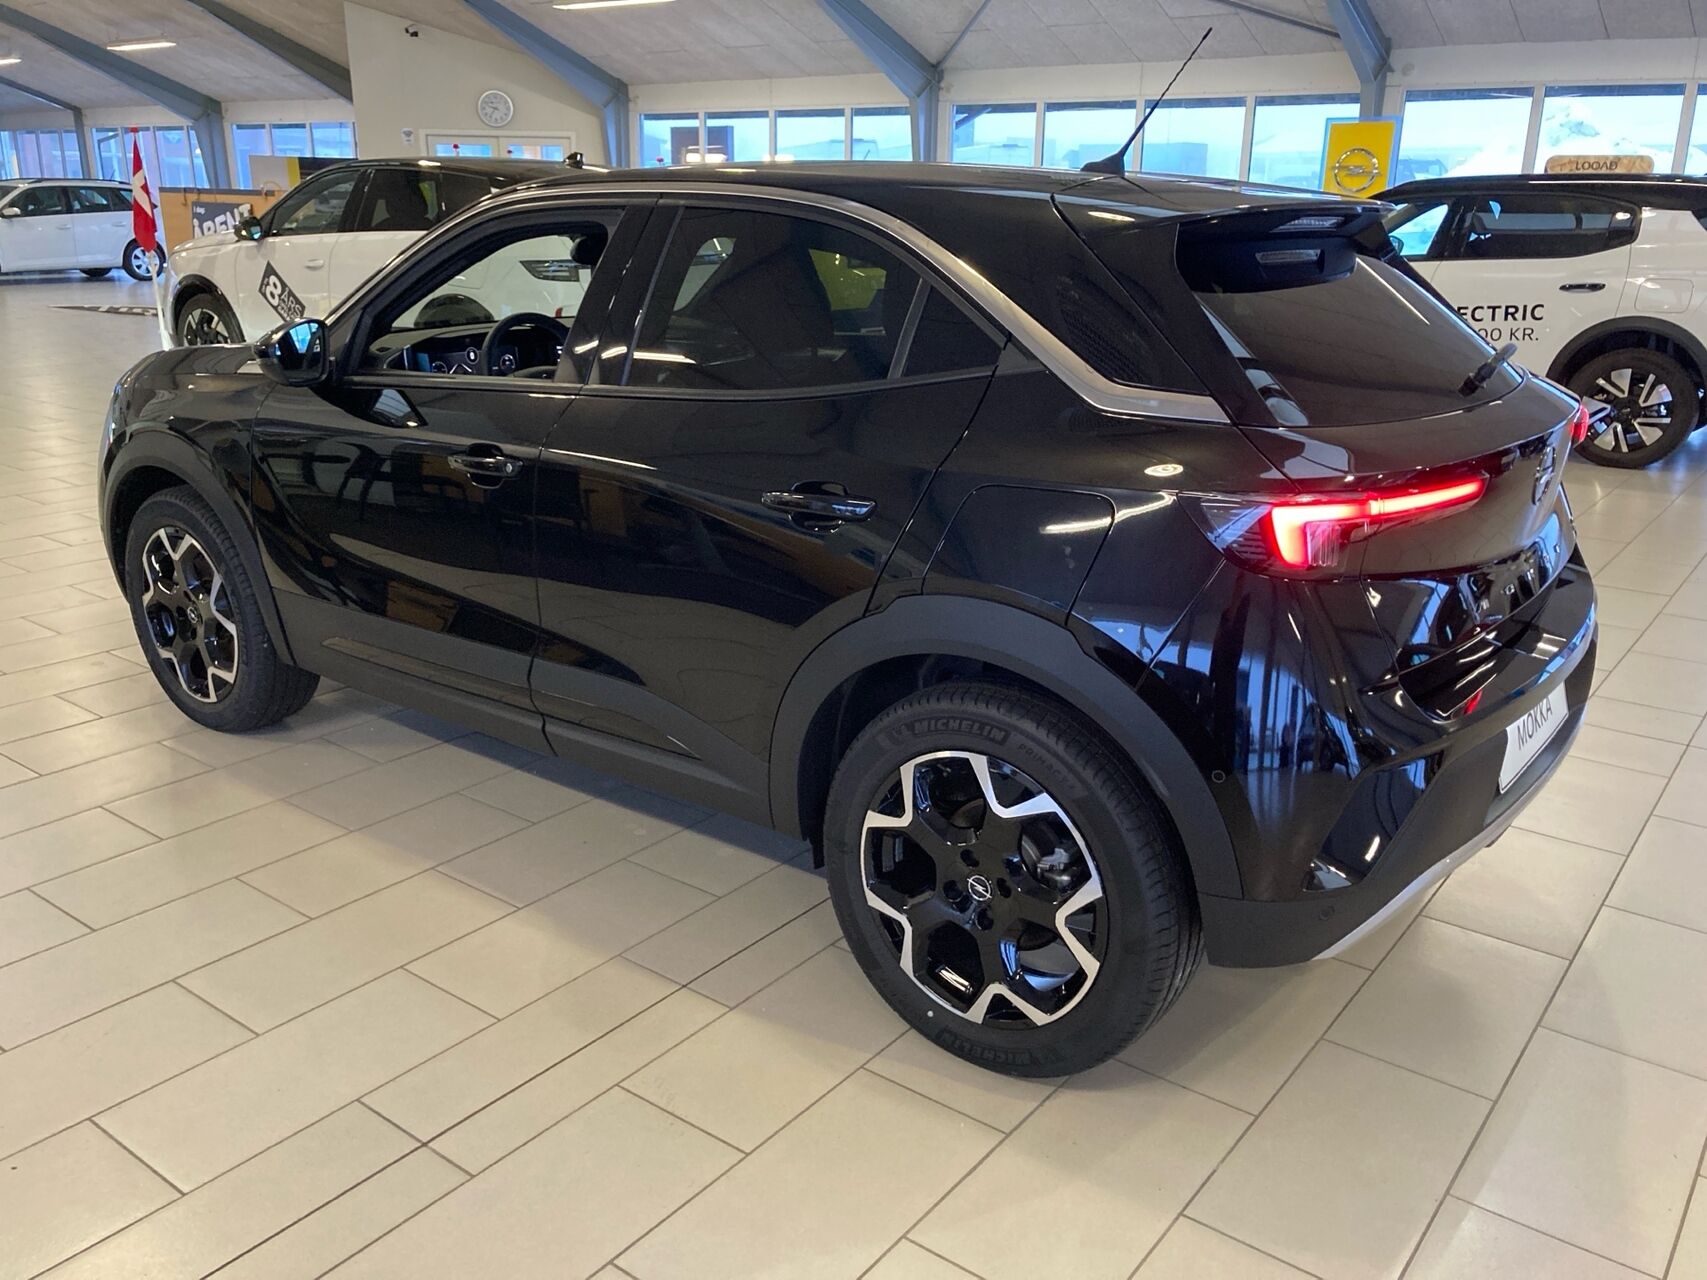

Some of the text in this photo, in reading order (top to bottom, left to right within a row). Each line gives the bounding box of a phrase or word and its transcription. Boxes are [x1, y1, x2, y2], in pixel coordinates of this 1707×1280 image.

[265, 275, 282, 306] 8
[1509, 327, 1539, 342] KR.
[913, 718, 1007, 742] MICHELIN
[1517, 697, 1553, 751] MOKKA
